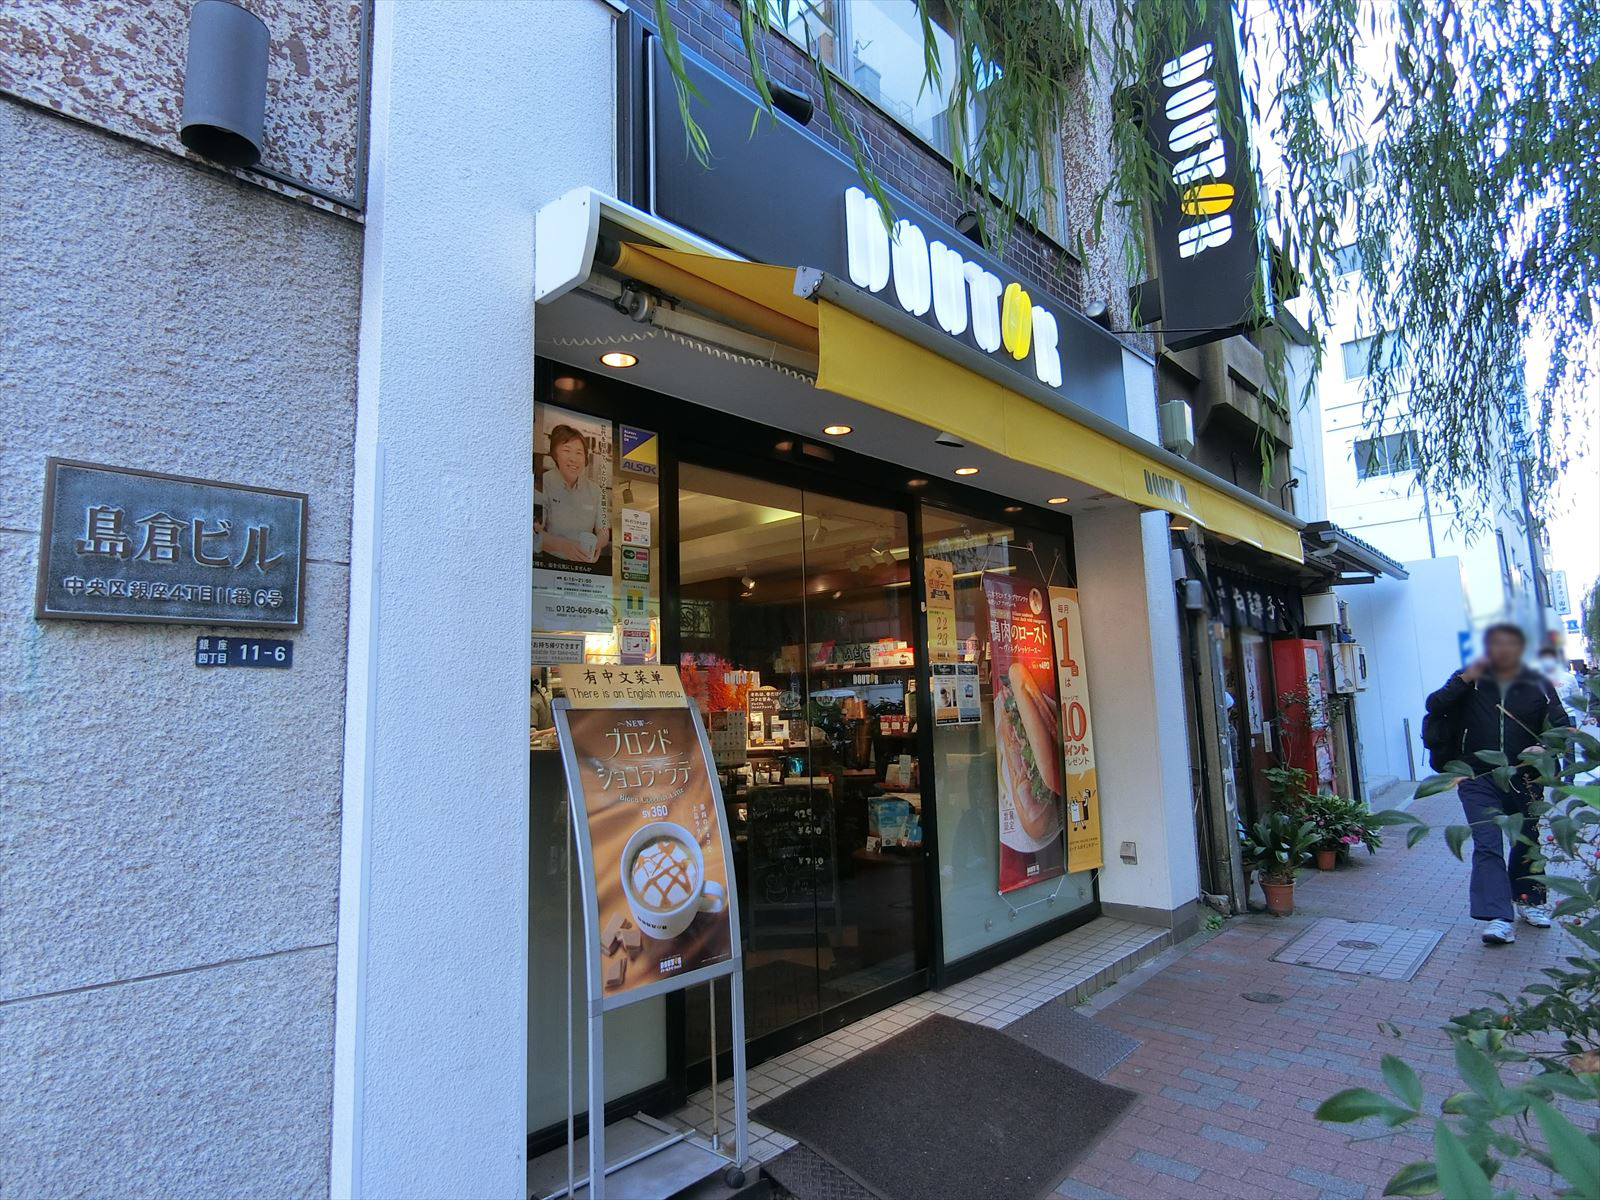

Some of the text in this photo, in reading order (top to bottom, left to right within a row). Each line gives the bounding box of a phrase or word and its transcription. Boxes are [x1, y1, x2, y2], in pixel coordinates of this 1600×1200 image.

[845, 186, 1063, 389] DOUTOR
[622, 461, 657, 475] ALSOK
[75, 505, 285, 574] 島倉ビル
[63, 576, 284, 608] 中央区銀座4丁目11番6号
[991, 620, 1048, 646] 鴨肉のロースト
[199, 639, 228, 650] 銀座
[239, 644, 286, 662] 11-6
[198, 653, 228, 665] 四丁目
[583, 669, 664, 685] 有中文菜单
[1064, 678, 1072, 688] は
[570, 688, 683, 700] There is an English menu.
[1061, 702, 1087, 743] 10
[605, 728, 672, 758] ブロンド
